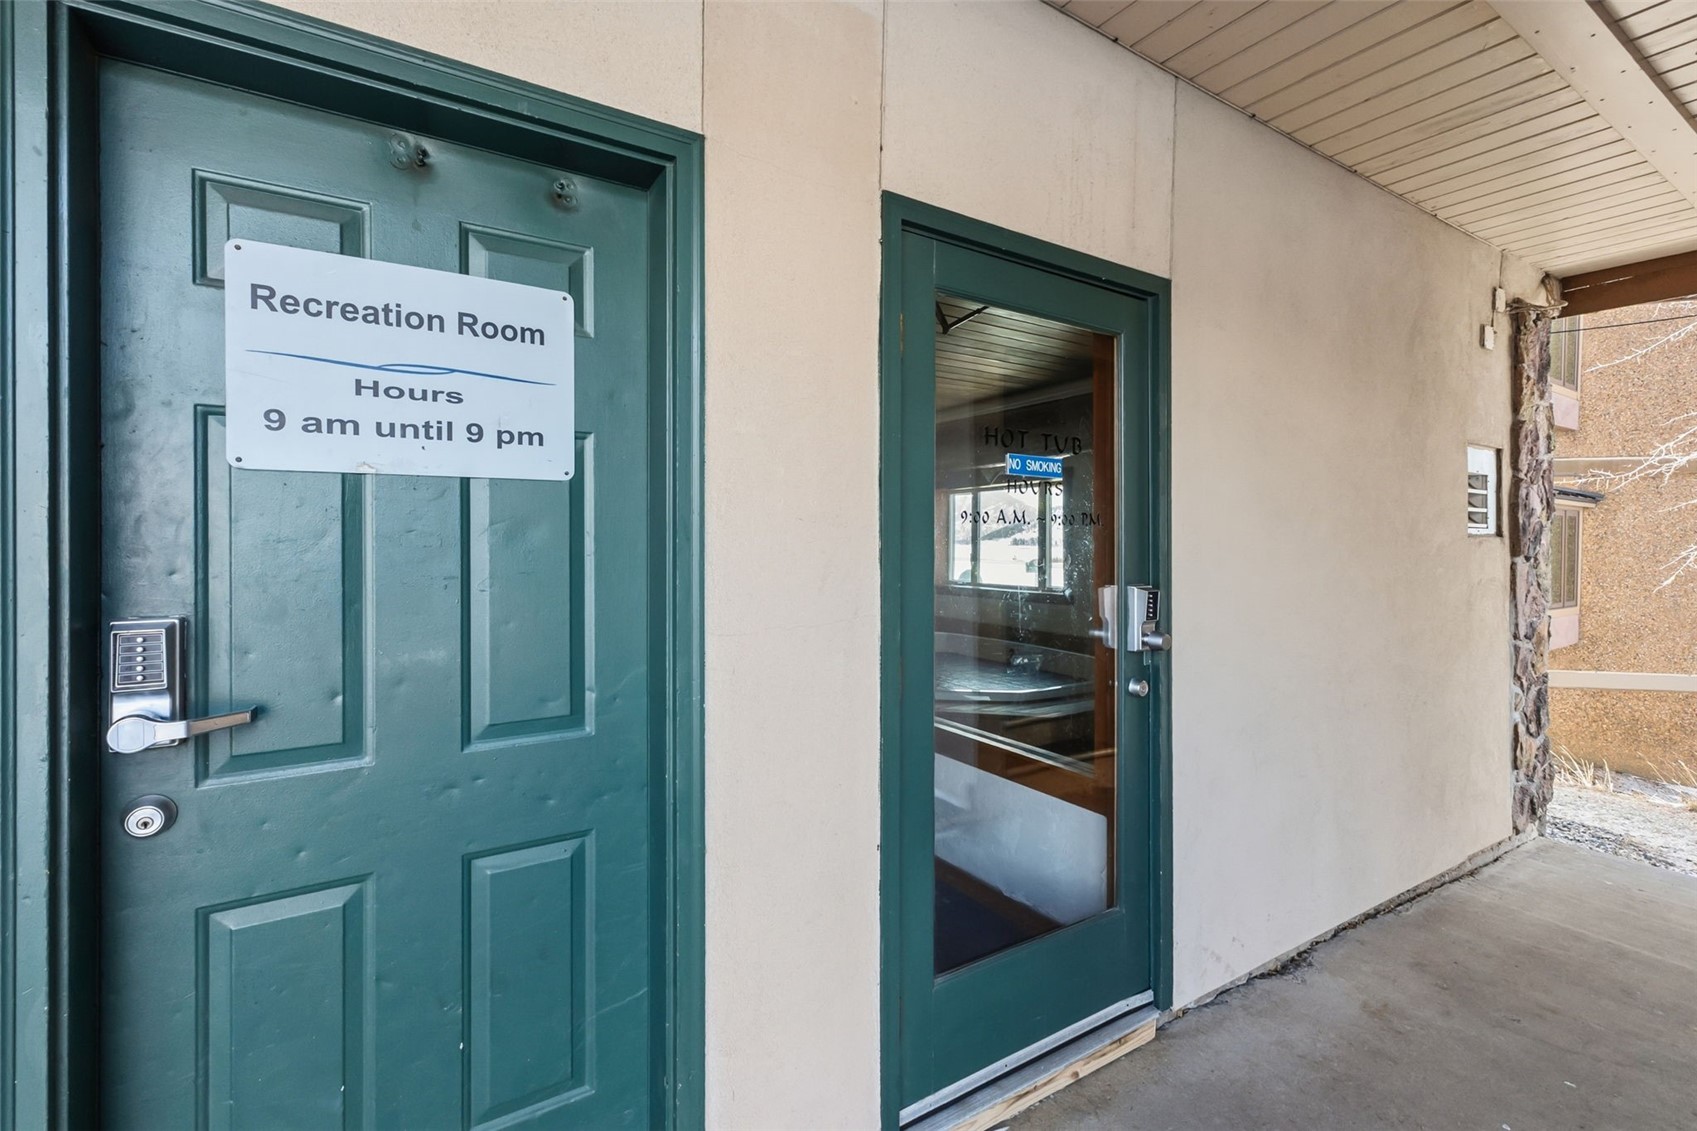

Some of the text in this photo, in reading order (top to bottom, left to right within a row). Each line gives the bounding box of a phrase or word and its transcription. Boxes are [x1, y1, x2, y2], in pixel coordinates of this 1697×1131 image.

[250, 283, 545, 346] Recreation Room
[354, 378, 464, 405] Hours
[262, 408, 544, 449] 9 am until 9 pm
[984, 427, 1029, 449] HOT
[1008, 458, 1062, 474] NO SMOKING
[1007, 479, 1063, 496] HOURS
[960, 510, 990, 525] 9:00
[996, 509, 1031, 526] A.M.
[1051, 513, 1075, 526] 9:00
